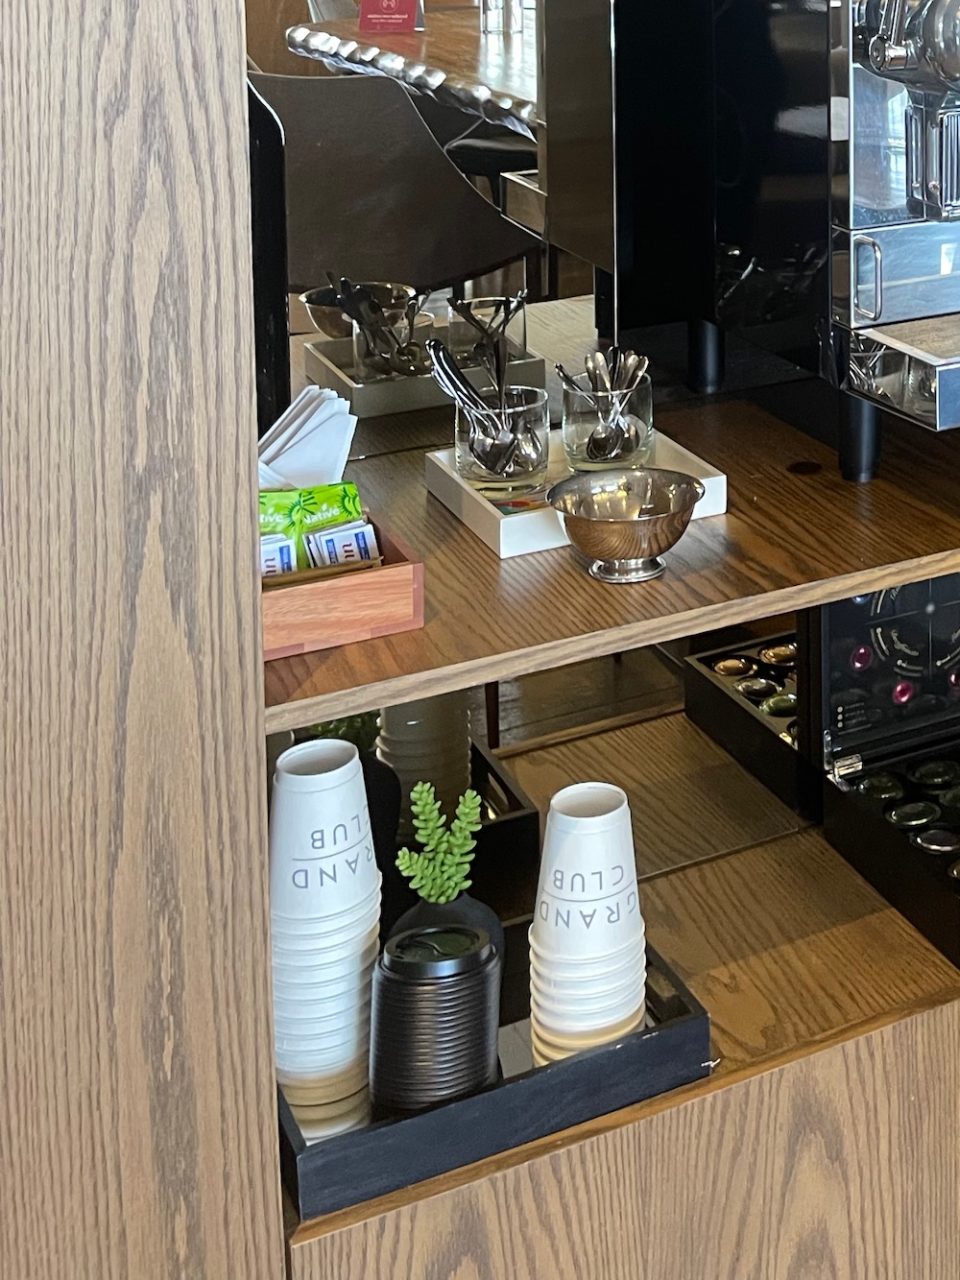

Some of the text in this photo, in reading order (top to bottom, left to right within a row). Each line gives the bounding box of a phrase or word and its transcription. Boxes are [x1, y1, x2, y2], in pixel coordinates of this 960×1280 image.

[301, 504, 341, 524] Native
[553, 865, 624, 892] CLUB
[540, 891, 637, 929] GRAND
